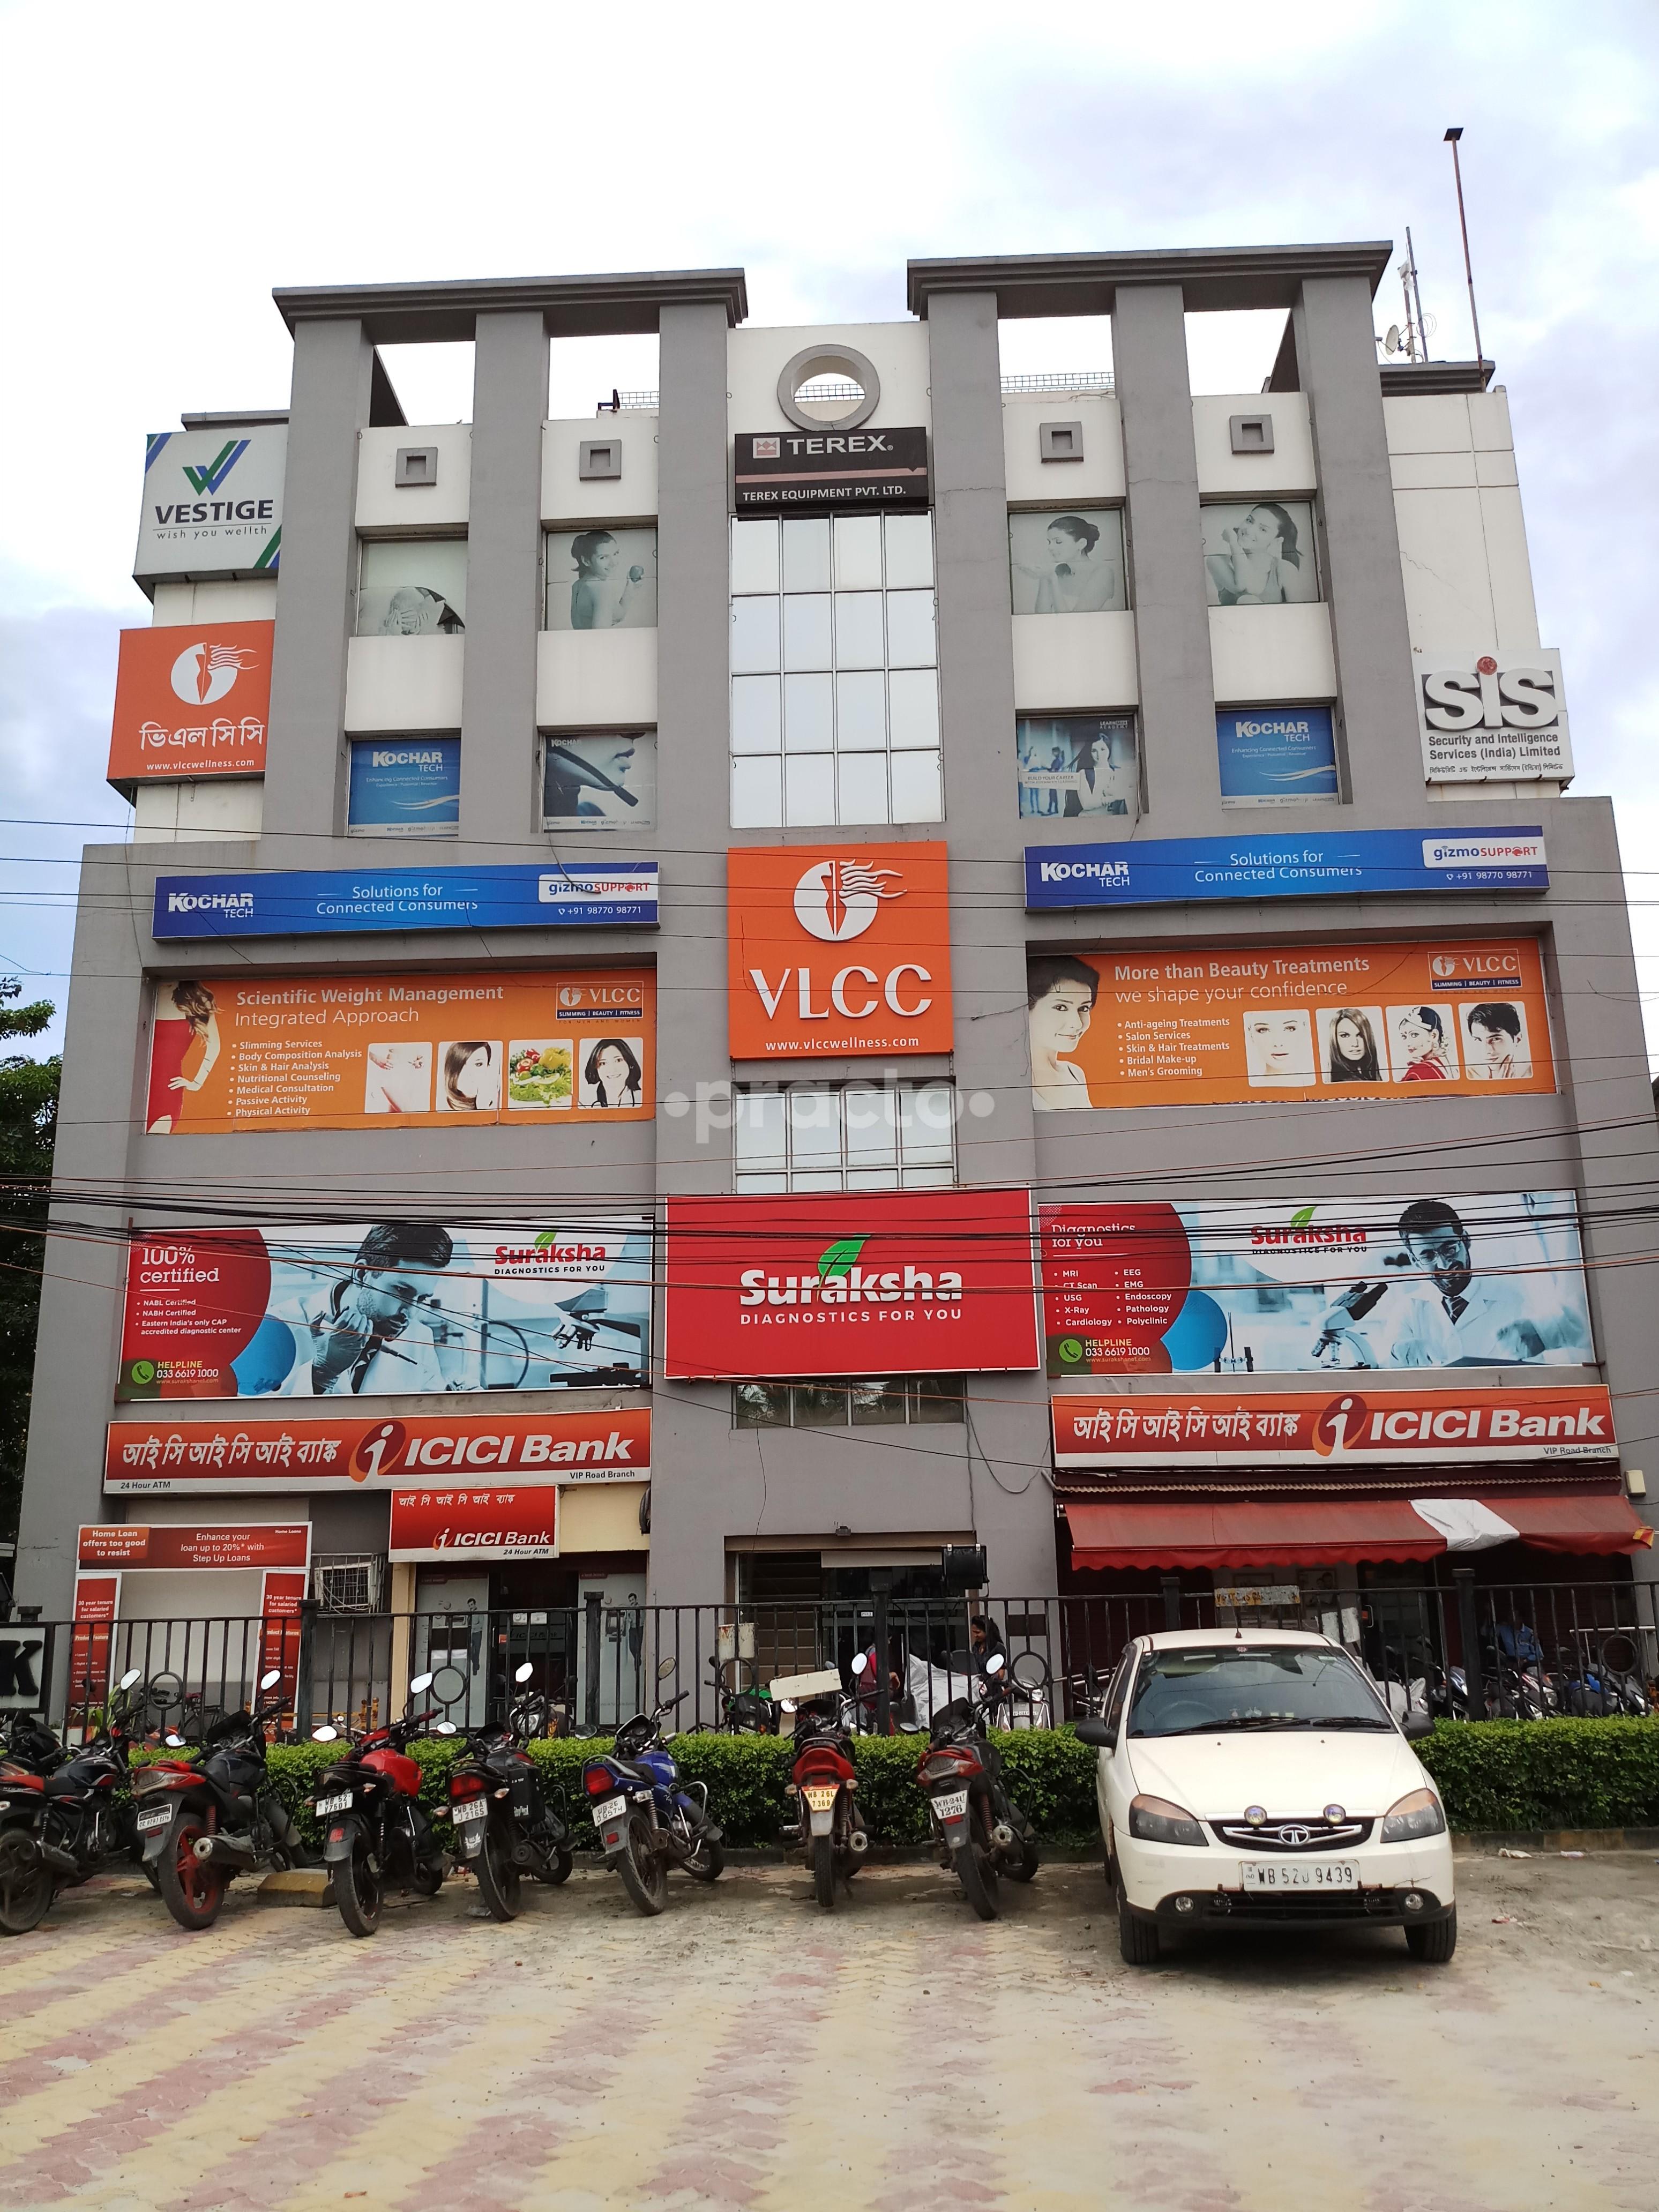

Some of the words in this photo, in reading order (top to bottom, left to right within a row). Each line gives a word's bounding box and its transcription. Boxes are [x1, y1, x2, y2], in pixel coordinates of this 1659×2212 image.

[743, 491, 779, 501] TEREX
[782, 488, 852, 500] EQUIPMENT
[855, 487, 879, 496] PVT.
[883, 485, 907, 495] LTD.
[155, 499, 274, 525] VESTIGE
[157, 529, 186, 540] wish
[194, 528, 218, 540] you
[225, 526, 267, 536] wellth
[1236, 721, 1309, 737] KOCHAR
[1284, 734, 1310, 742] TECH
[1429, 735, 1471, 746] Security
[1475, 734, 1494, 744] and
[1498, 733, 1558, 745] Intelligence
[372, 751, 443, 767] KOCHAR
[1430, 749, 1477, 760] Services
[1481, 748, 1516, 760] (India)
[1520, 746, 1560, 757] Limited
[146, 759, 255, 771] www.vlccwellness.com
[419, 764, 443, 772] TECH
[1230, 851, 1299, 866] Solutions
[1303, 850, 1324, 863] for
[1041, 862, 1129, 882] KOCHAR
[1195, 867, 1275, 883] Connected
[1279, 868, 1362, 880] Consumers
[1456, 872, 1472, 880] +91
[1476, 871, 1503, 880] 98770
[1099, 877, 1130, 887] TECH
[353, 885, 419, 899] Solutions
[423, 884, 443, 896] for
[168, 892, 253, 912] KOCHAR
[317, 901, 394, 915] Connected
[398, 900, 478, 911] Consumers
[223, 908, 253, 918] TECH
[1115, 966, 1159, 980] More
[1165, 964, 1204, 979] than
[1209, 962, 1269, 979] Beauty
[1273, 958, 1370, 975] Treatments
[1463, 955, 1517, 973] VLCC
[236, 989, 317, 1006] Scientific
[322, 988, 383, 1006] Weight
[389, 986, 504, 1004] Management
[590, 988, 640, 1003] VLCC
[749, 964, 932, 1020] VLCC
[1116, 990, 1142, 1003] we
[1148, 986, 1199, 1005] shape
[1205, 987, 1245, 1006] your
[1250, 980, 1348, 998] confidence
[235, 1008, 326, 1028] Integrated
[332, 1007, 420, 1027] Approach
[1124, 1019, 1177, 1029] Anti-ageing
[1179, 1018, 1230, 1027] Treatments
[1126, 1032, 1151, 1041] Salon
[1153, 1031, 1191, 1040] Services
[240, 1041, 282, 1050] Slimming
[285, 1040, 323, 1049] Services
[765, 1035, 920, 1051] www.vlccwellness.com
[1126, 1043, 1146, 1052] Skin
[1149, 1043, 1155, 1052] &
[1159, 1043, 1177, 1051] Hair
[1179, 1042, 1230, 1051] Treatments
[239, 1052, 262, 1062] Body
[265, 1051, 323, 1062] Composition
[325, 1049, 362, 1059] Analysis
[1127, 1056, 1154, 1065] Bridal
[1156, 1055, 1197, 1065] Make-up
[237, 1074, 288, 1083] Nutritional
[290, 1072, 341, 1083] Counseling
[1128, 1067, 1155, 1077] Men's
[1157, 1066, 1202, 1077] Grooming
[237, 1085, 273, 1094] Medical
[276, 1083, 334, 1093] Consultation
[236, 1097, 269, 1105] Passive
[272, 1095, 308, 1105] Activity
[235, 1107, 272, 1117] Physical
[275, 1107, 310, 1116] Activity
[141, 1245, 195, 1265] 100%
[495, 1243, 606, 1265] Suraksha
[140, 1268, 220, 1283] certified
[494, 1267, 560, 1275] DIAGNOSTICS
[739, 1265, 963, 1307] Suraksha
[1126, 1305, 1169, 1313] Pathology
[741, 1311, 870, 1325] DIAGNOSTICS
[879, 1310, 915, 1322] FOR
[924, 1308, 962, 1321] YOU
[1065, 1318, 1112, 1326] Cardiology
[1126, 1317, 1168, 1325] Polyclinic
[1085, 1339, 1132, 1347] HELPLINE
[1085, 1348, 1103, 1357] 033
[1104, 1347, 1126, 1356] 6619
[1128, 1347, 1150, 1356] 1000
[156, 1370, 174, 1378] 033
[175, 1369, 196, 1378] 6619
[198, 1369, 219, 1377] 1000
[1073, 1408, 1114, 1443] আই
[1115, 1408, 1141, 1438] সি
[1142, 1407, 1183, 1442] আই
[1185, 1406, 1210, 1438] সি
[1212, 1406, 1253, 1441] আই
[1370, 1410, 1481, 1440] ICICI
[1489, 1407, 1606, 1438] Bank
[123, 1435, 163, 1469] আই
[162, 1433, 187, 1464] সি
[189, 1433, 228, 1468] আই
[229, 1433, 254, 1464] সি
[256, 1432, 296, 1468] আই
[405, 1435, 514, 1467] ICICI
[520, 1431, 634, 1463] Bank
[586, 1471, 606, 1479] Road
[608, 1470, 635, 1478] Branch
[125, 1539, 146, 1548] good
[196, 1533, 230, 1541] Enhance
[232, 1533, 251, 1542] your
[453, 1532, 502, 1546] ICICI
[504, 1530, 551, 1545] Bank
[193, 1555, 211, 1563] Step
[213, 1554, 225, 1563] Up
[227, 1554, 251, 1562] Loans
[469, 1800, 484, 1811] 26A
[940, 1804, 963, 1817] 1276
[459, 1813, 463, 1821] J
[465, 1808, 484, 1820] 2165
[1258, 1867, 1275, 1884] WB
[1315, 1867, 1352, 1884] 9439
